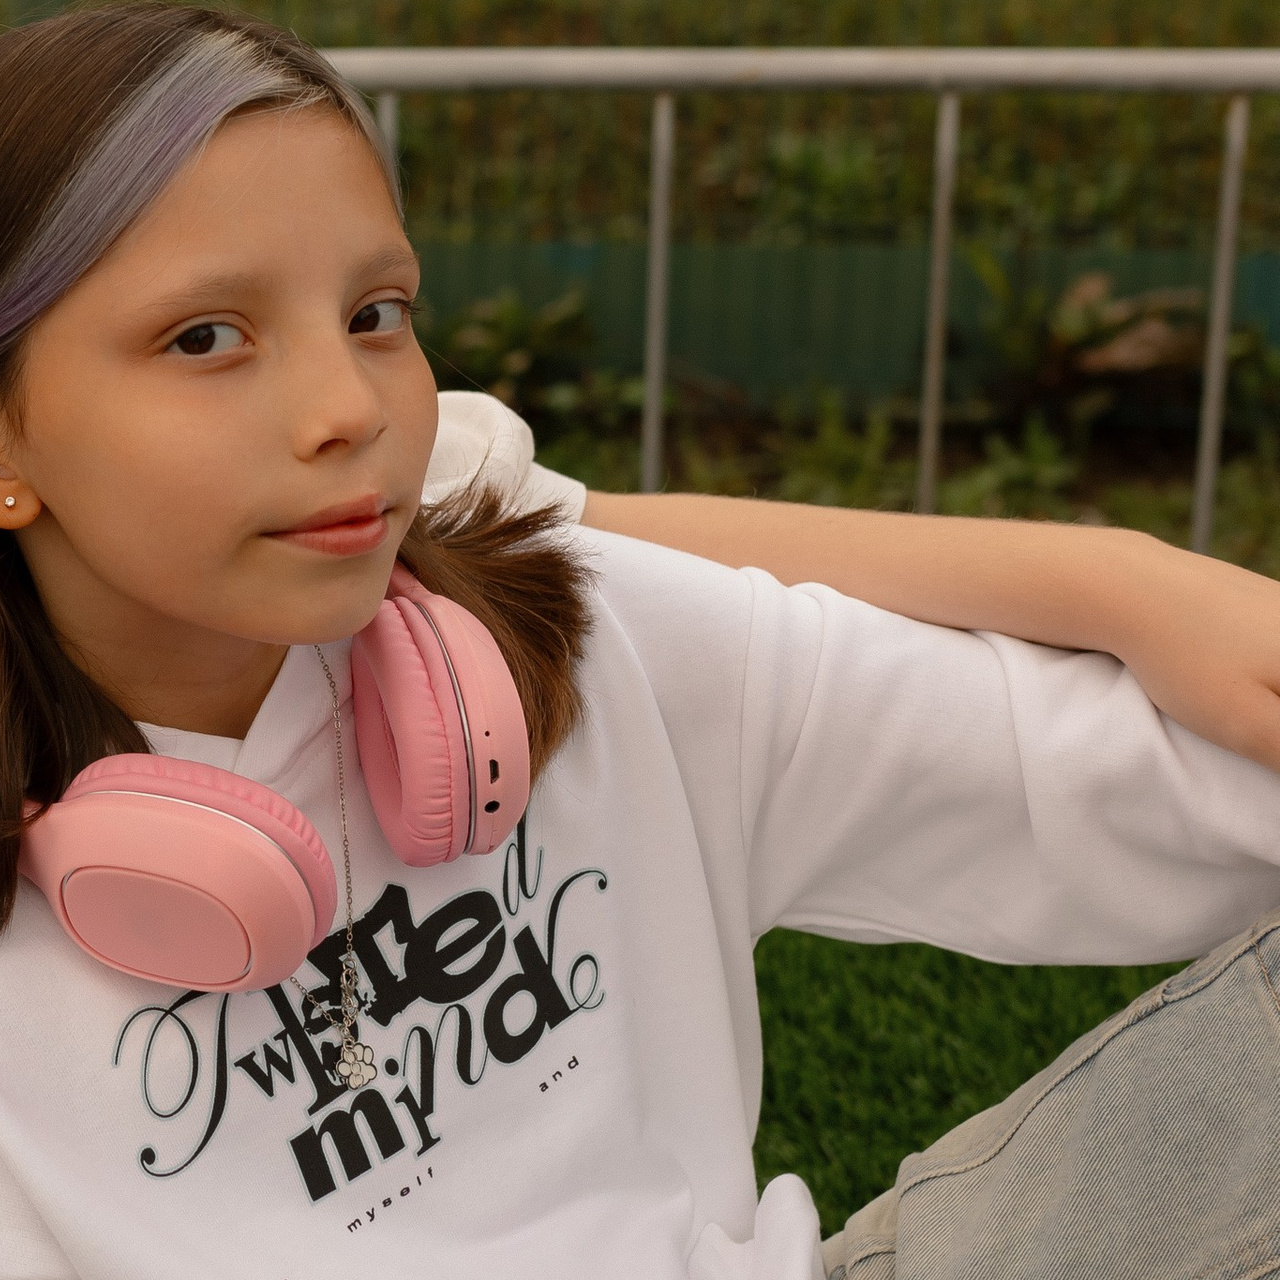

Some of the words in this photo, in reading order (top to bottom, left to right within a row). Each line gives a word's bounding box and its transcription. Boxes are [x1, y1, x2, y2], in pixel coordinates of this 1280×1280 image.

[290, 869, 608, 1203] mind
[347, 1166, 433, 1233] myself
[538, 1055, 580, 1093] and
